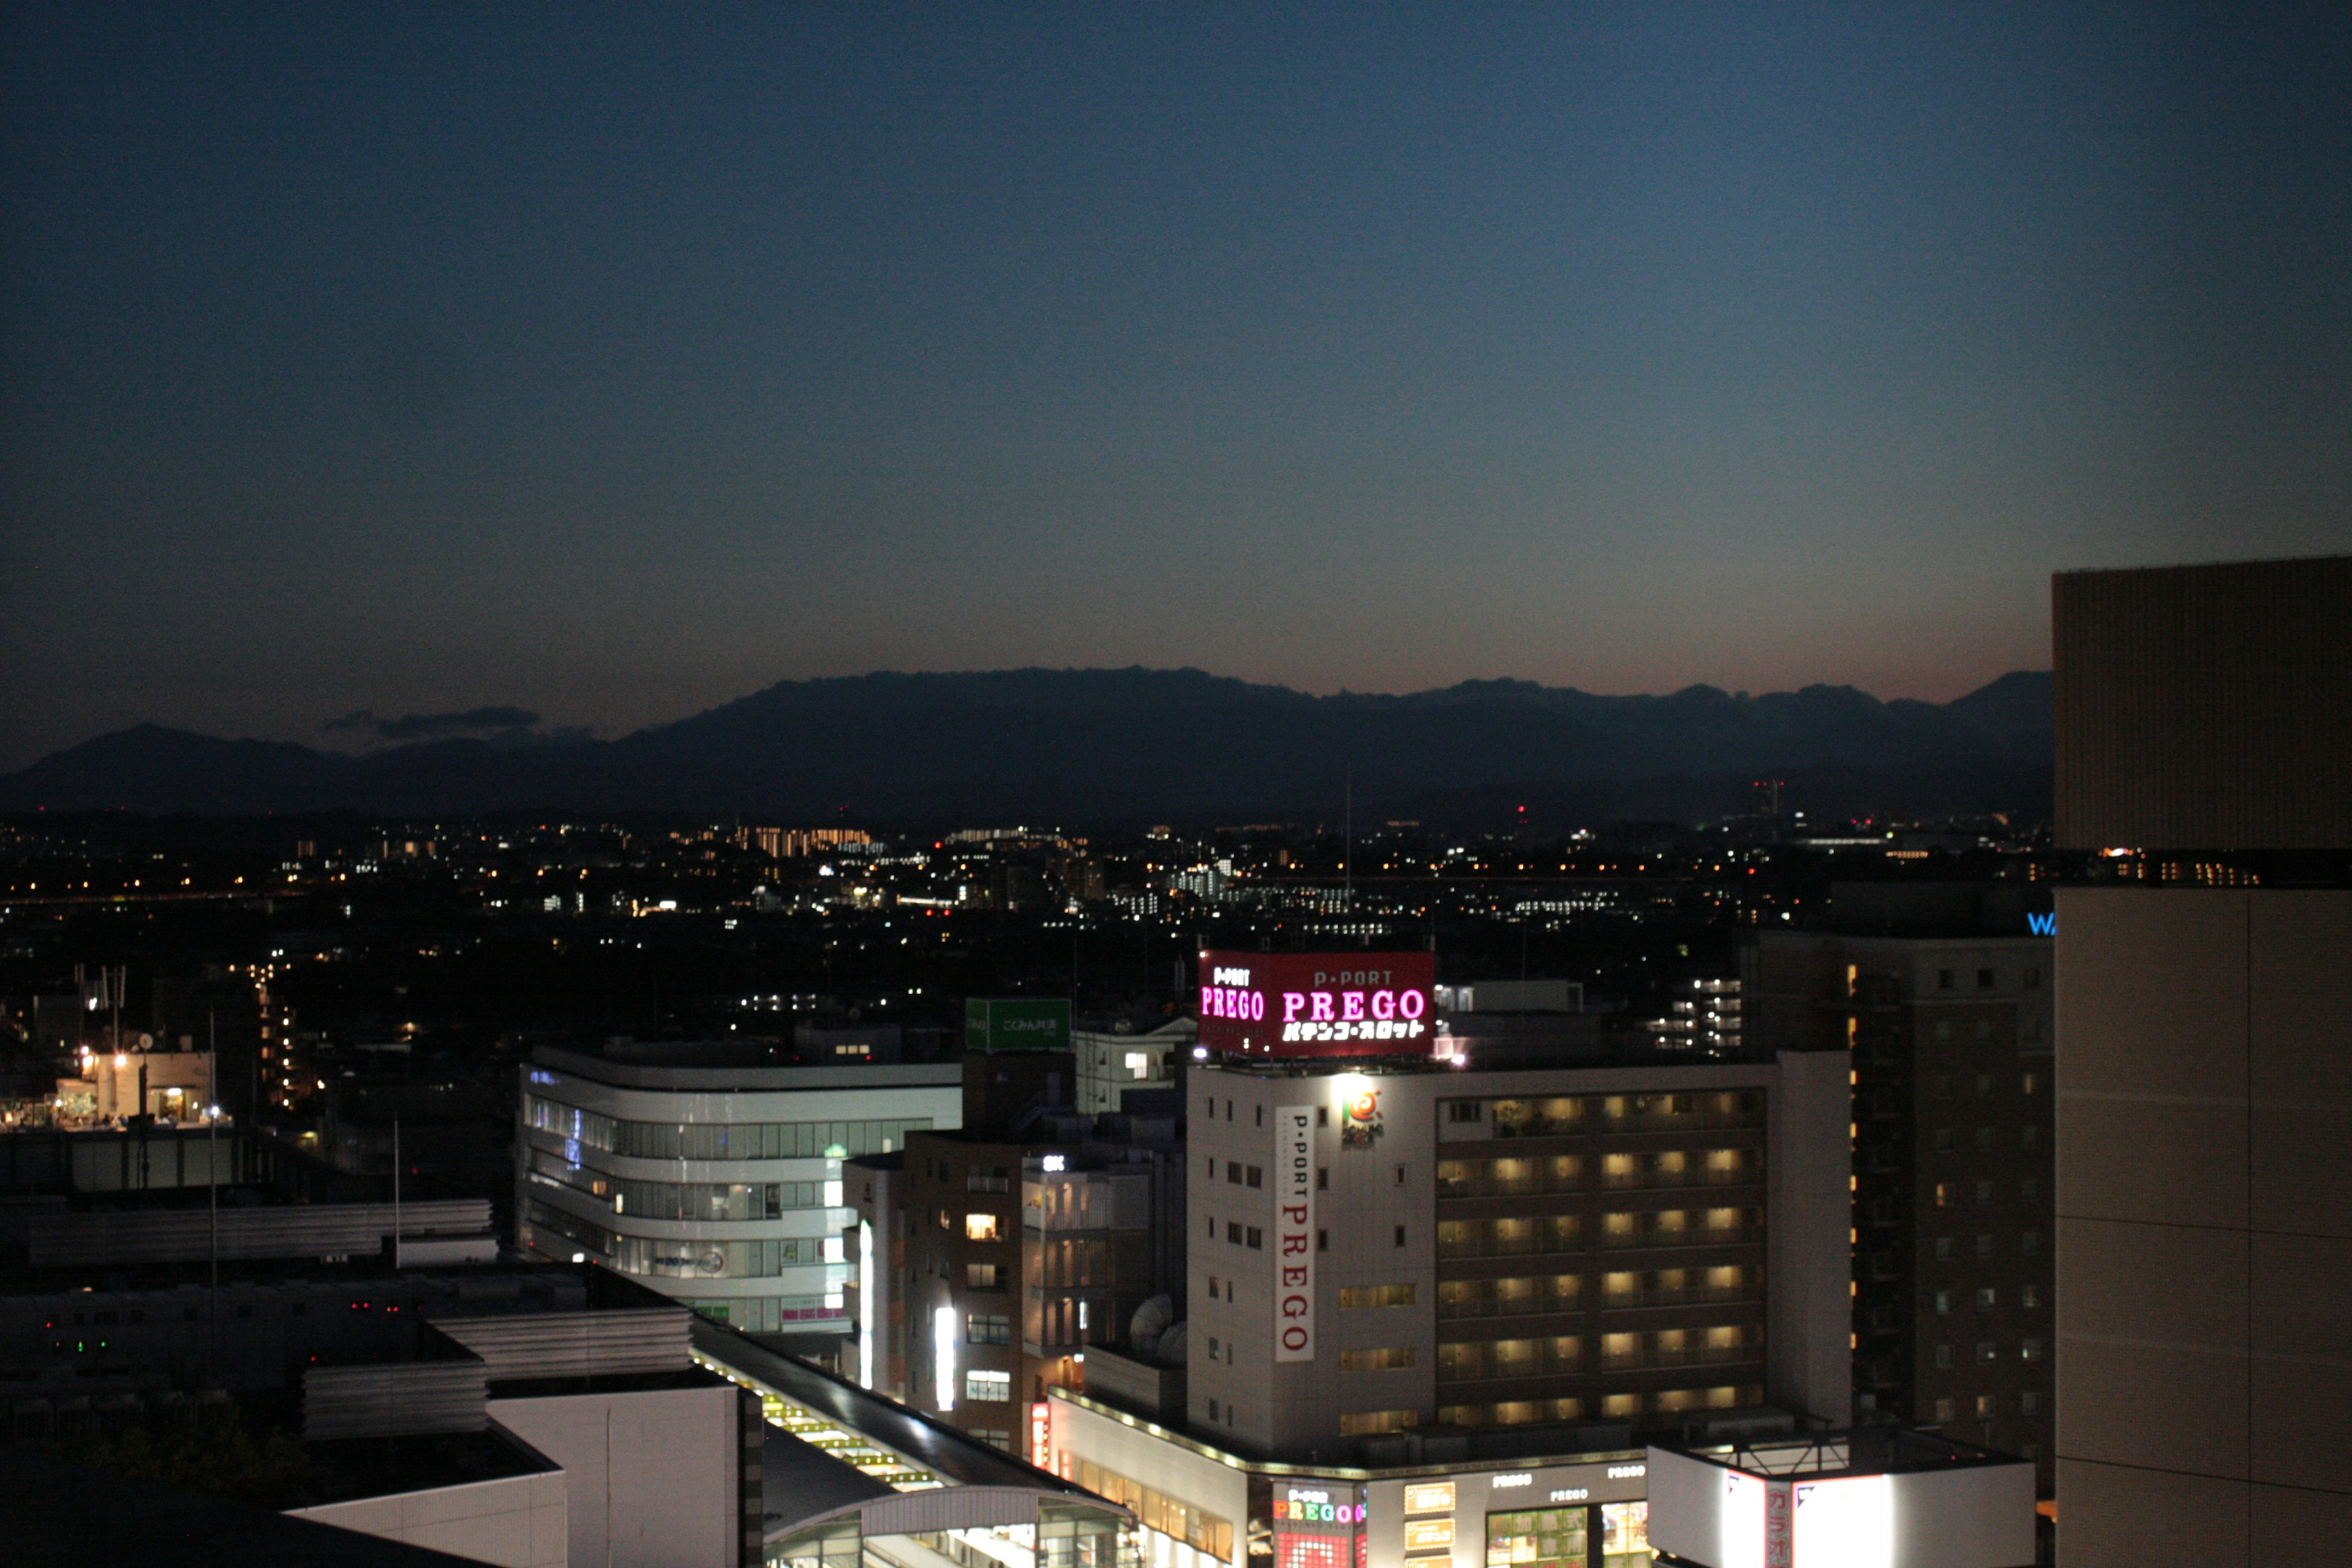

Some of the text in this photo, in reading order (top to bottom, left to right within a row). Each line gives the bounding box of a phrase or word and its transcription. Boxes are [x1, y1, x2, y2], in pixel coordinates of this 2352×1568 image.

[1202, 987, 1264, 1021] PREGO
[1283, 989, 1425, 1022] PREGO
[1283, 1019, 1425, 1041] パチンコ・スロット
[1282, 1202, 1308, 1352] PREGO
[1493, 1474, 1532, 1488] PREGO
[1608, 1465, 1646, 1479] PREGO
[1550, 1489, 1588, 1501] PREGO
[1273, 1500, 1352, 1524] PREGO
[1769, 1491, 1787, 1568] カラオ
